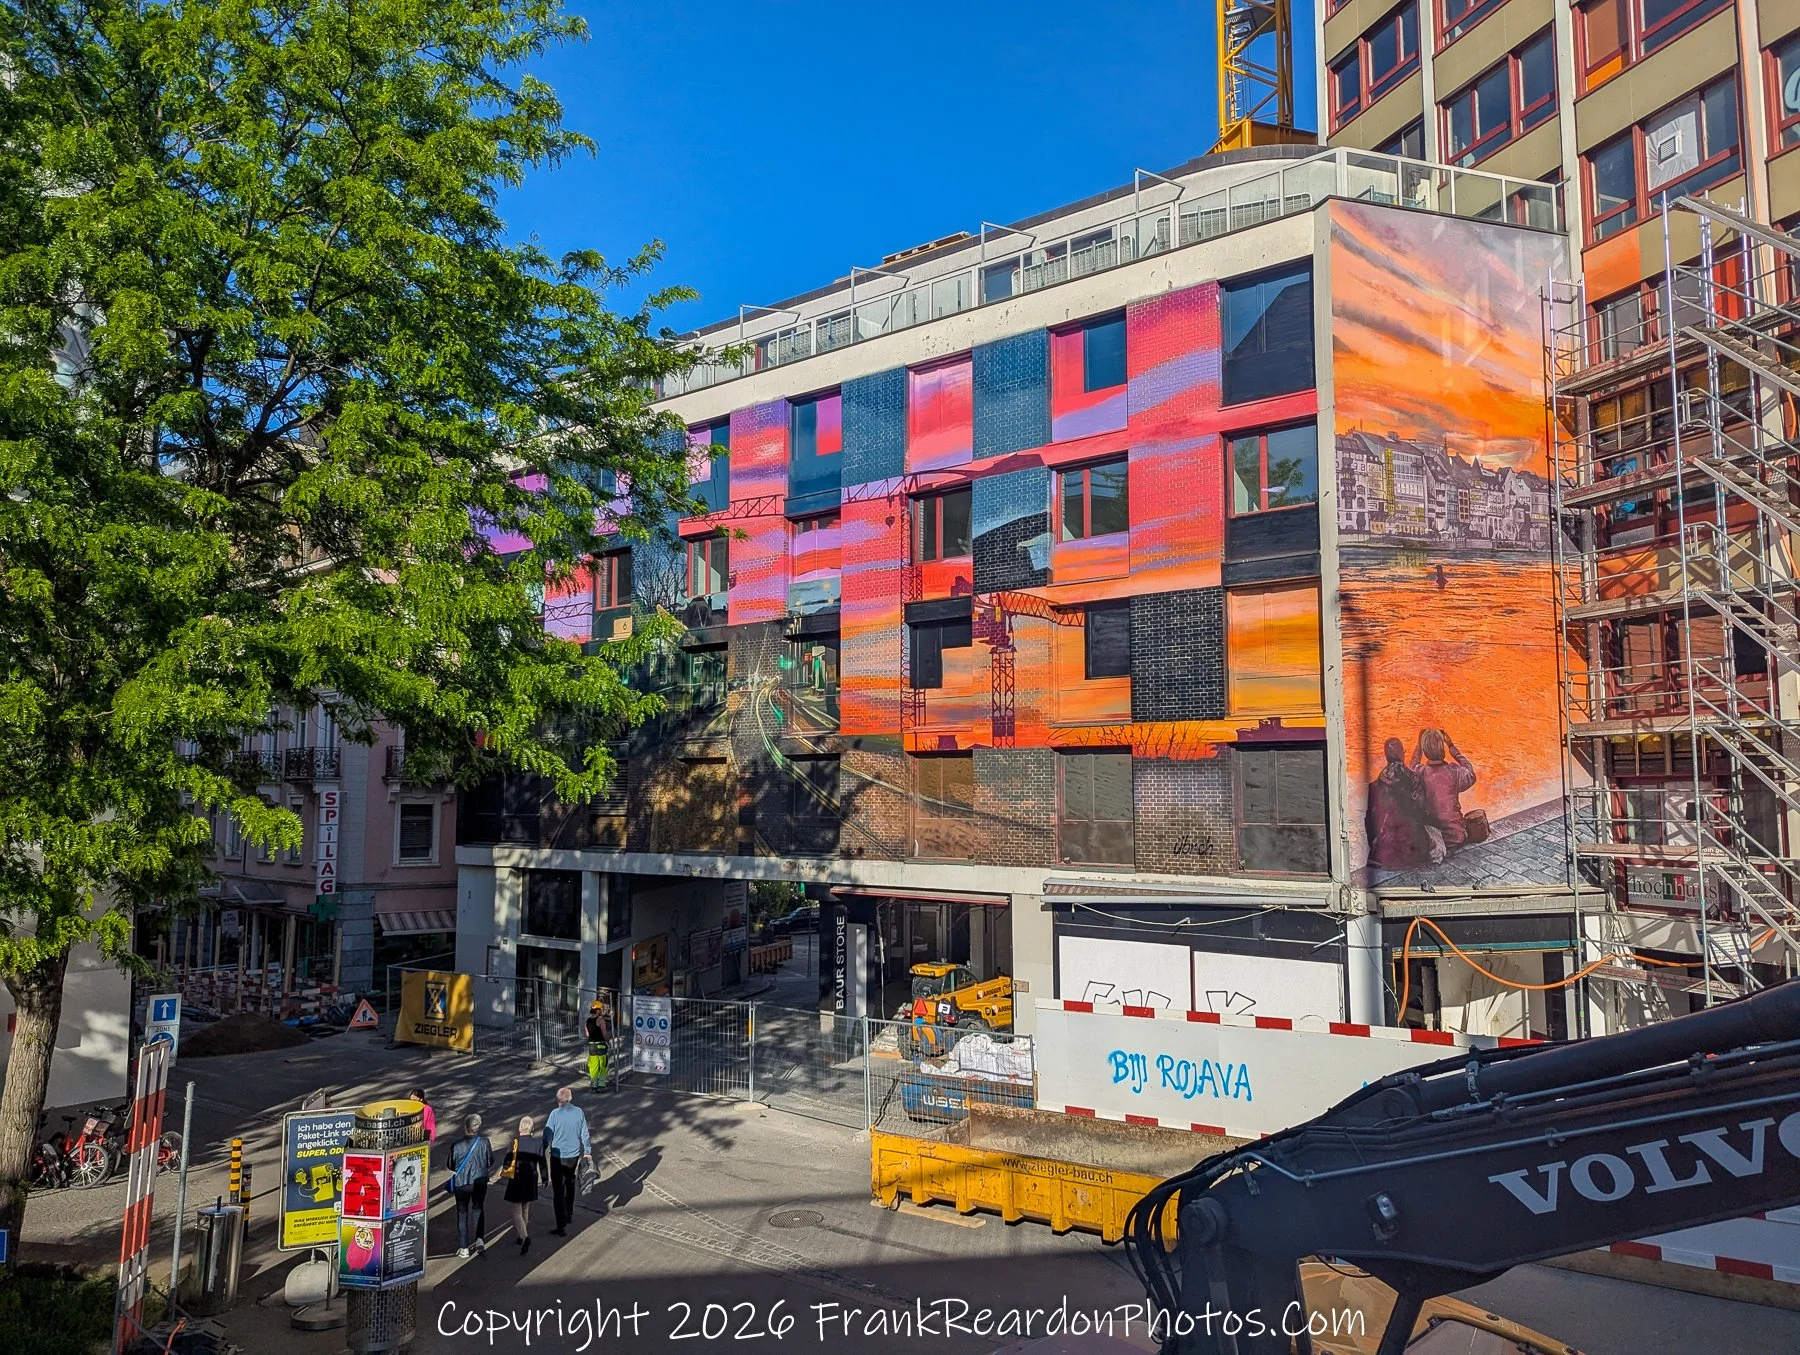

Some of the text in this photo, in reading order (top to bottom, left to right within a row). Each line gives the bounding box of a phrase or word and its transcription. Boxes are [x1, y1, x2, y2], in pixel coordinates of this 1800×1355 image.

[835, 915, 845, 1010] BAUR STORE
[414, 1022, 458, 1039] ZIEGLER
[1156, 1054, 1253, 1102] ROJAVA
[298, 1121, 351, 1132] Ich habe den
[297, 1129, 340, 1141] Paket-Link
[296, 1138, 340, 1150] angeklickt.
[296, 1148, 328, 1158] SUPER,
[1001, 1158, 1113, 1184] www.ziegler-bau.ch
